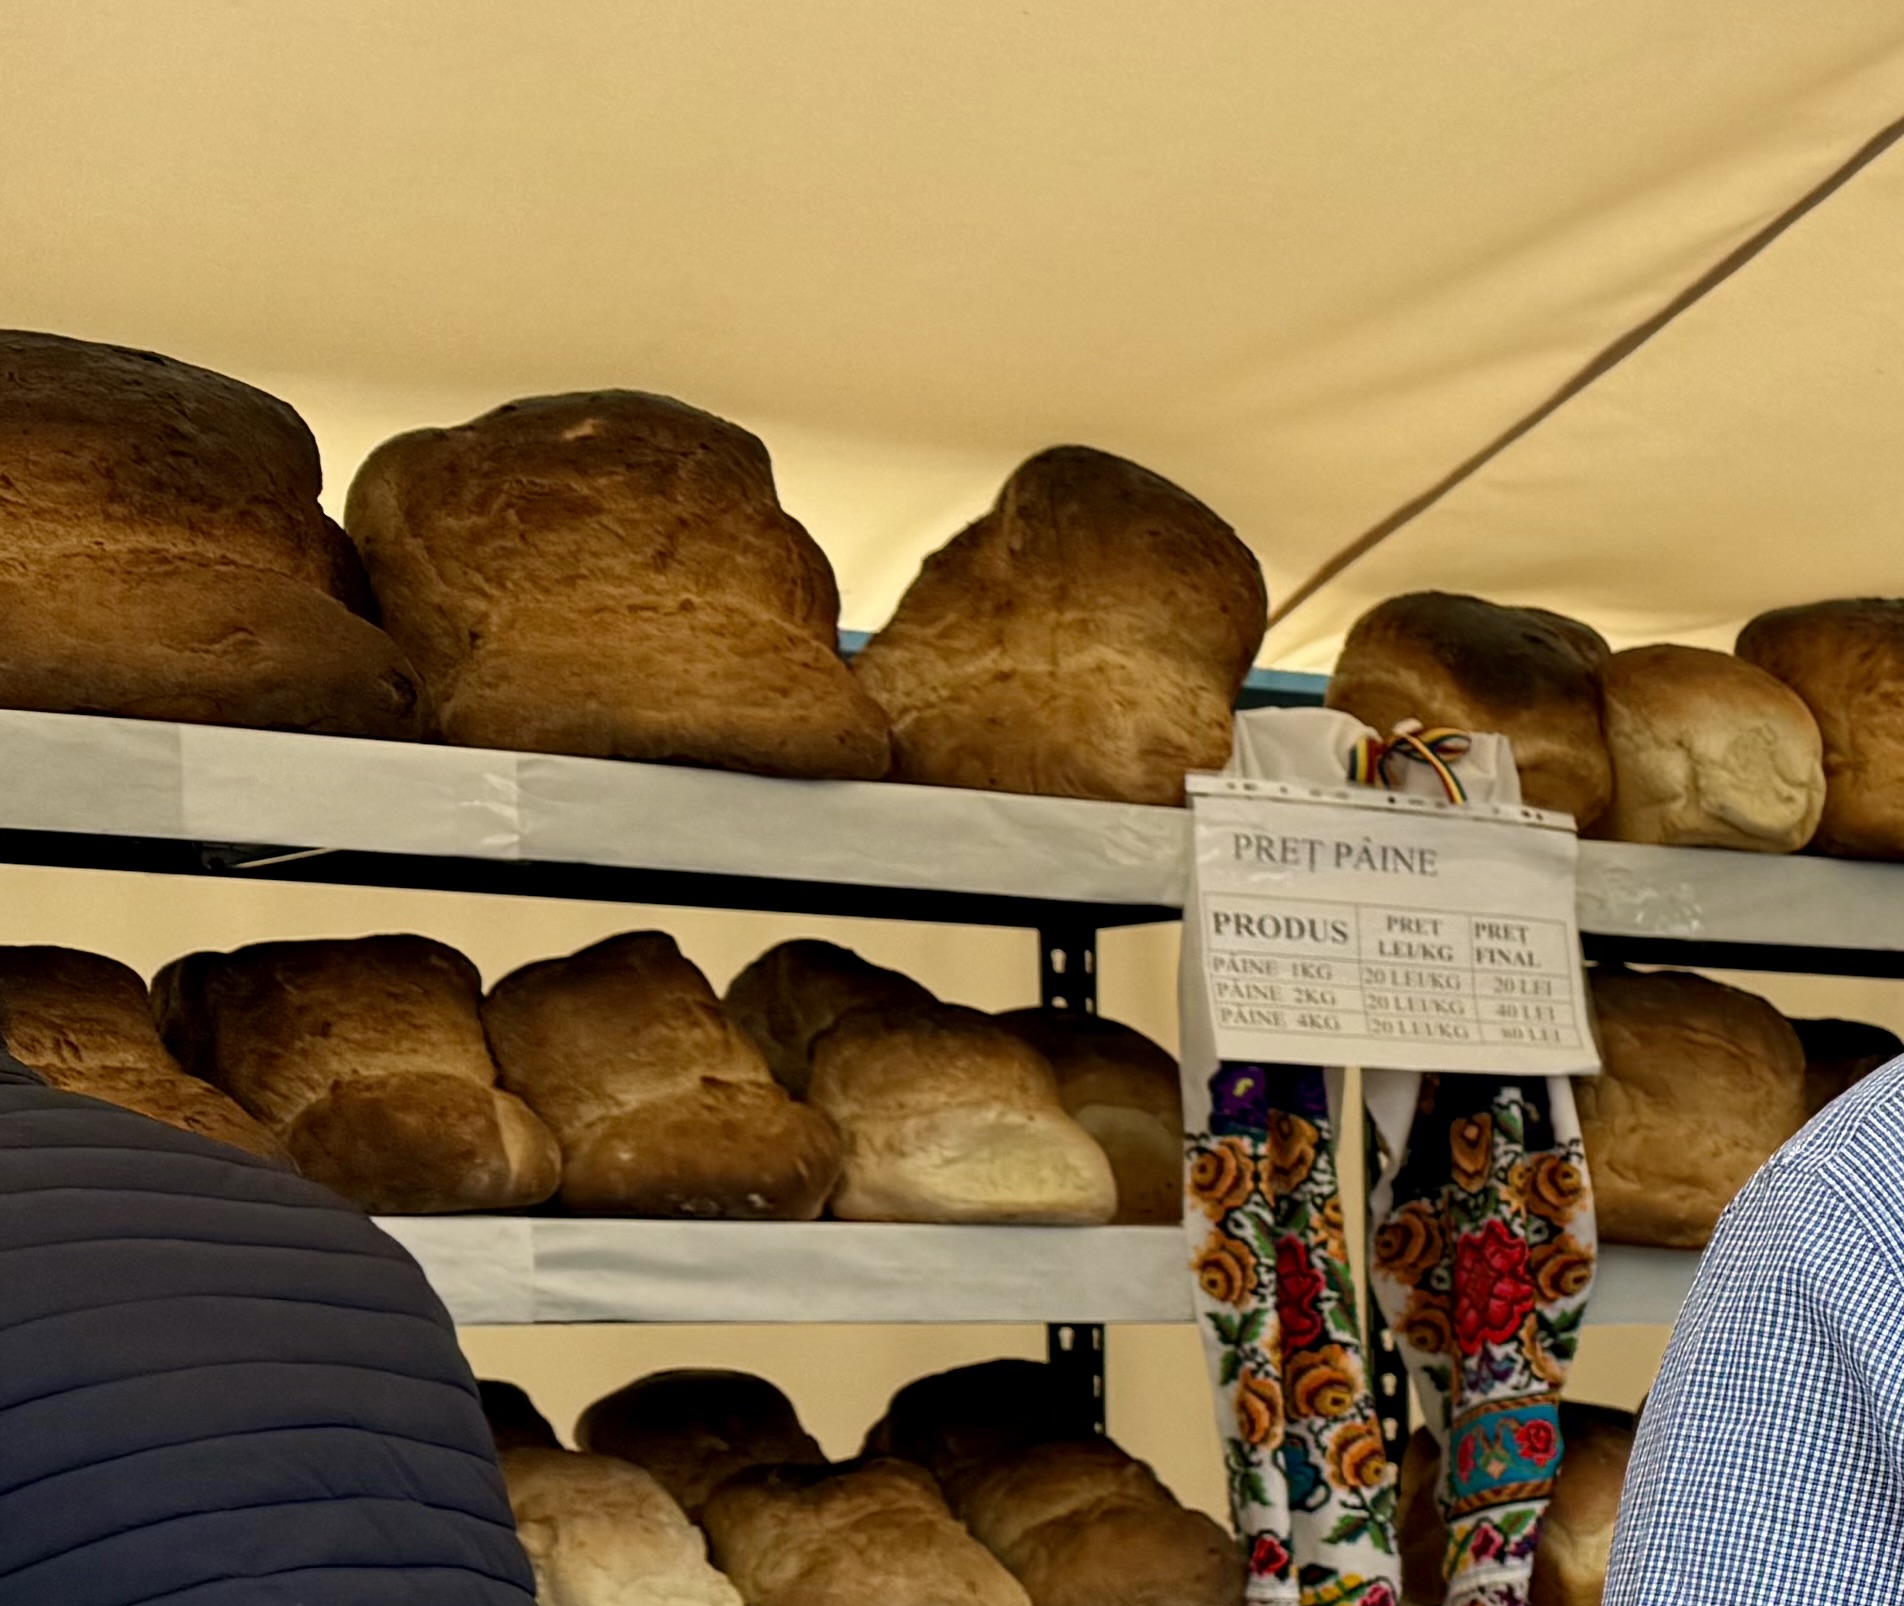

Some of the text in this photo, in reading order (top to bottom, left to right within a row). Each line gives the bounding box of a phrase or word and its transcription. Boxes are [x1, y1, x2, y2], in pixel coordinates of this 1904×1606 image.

[1334, 836, 1438, 876] PÂINE
[1213, 911, 1348, 944] PRODUS
[1475, 947, 1541, 968] FINAL
[1292, 962, 1332, 980] 1KG
[1364, 967, 1385, 984] 20
[1494, 976, 1552, 996] 20 LEI
[1367, 994, 1388, 1010] 20
[1522, 1005, 1555, 1021] LEI
